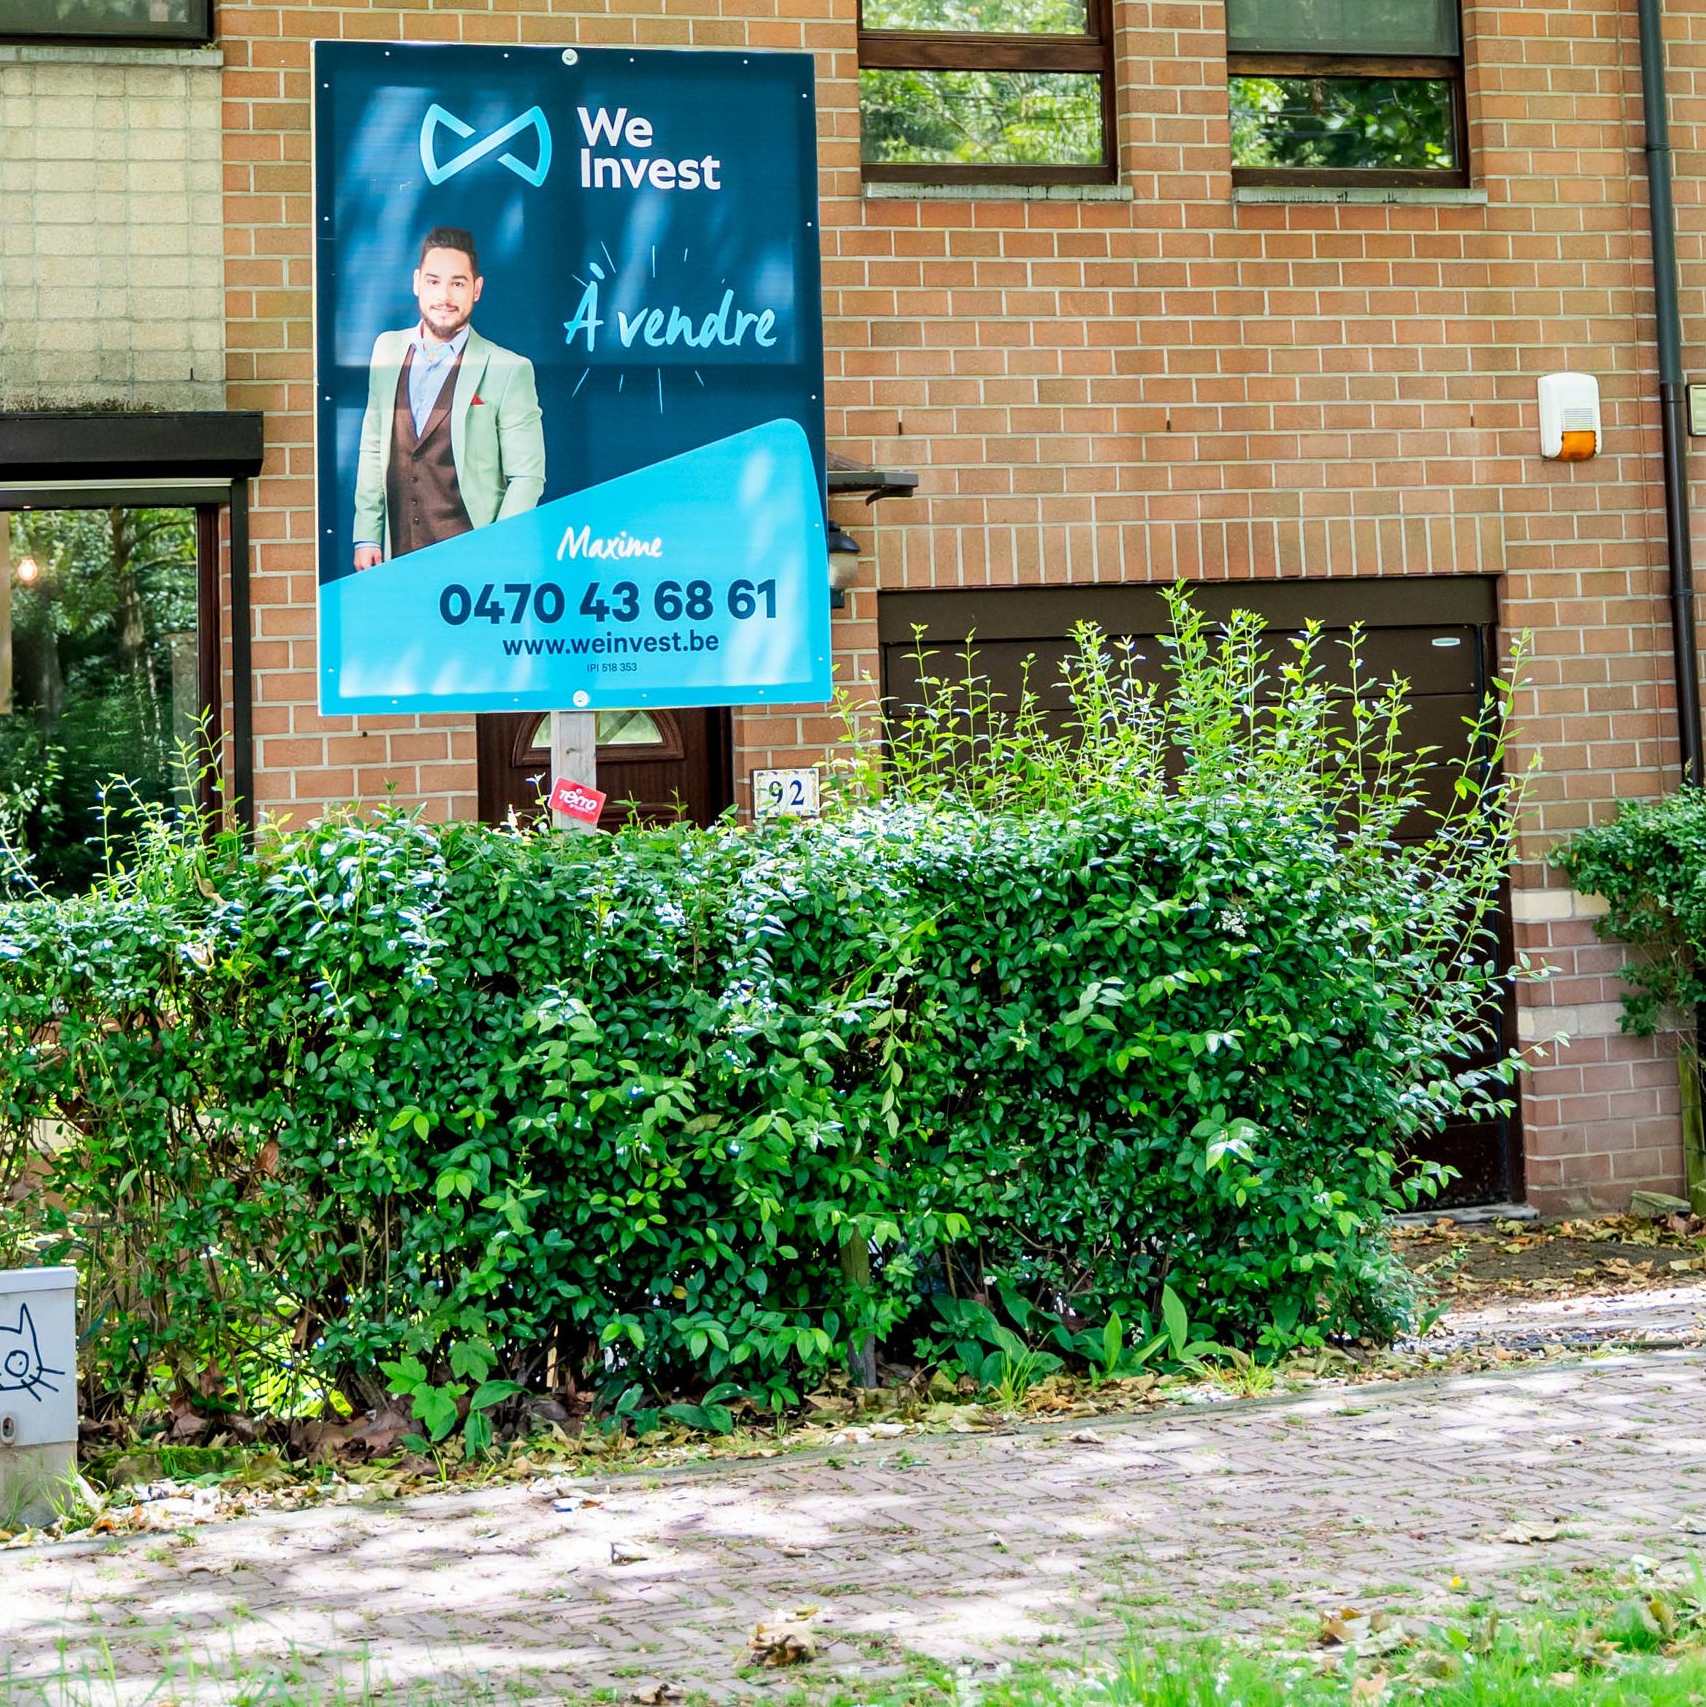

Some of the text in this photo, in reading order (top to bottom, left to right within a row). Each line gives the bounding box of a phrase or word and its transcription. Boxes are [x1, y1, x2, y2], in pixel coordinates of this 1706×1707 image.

[577, 106, 653, 148] We
[580, 148, 721, 190] Invest
[563, 261, 778, 352] À vendre
[556, 525, 663, 562] Maxime
[439, 578, 777, 626] 0470 43 68 61
[502, 629, 720, 656] www.weinvest.be
[602, 663, 618, 672] 518
[619, 662, 638, 672] 353
[768, 780, 805, 806] 92
